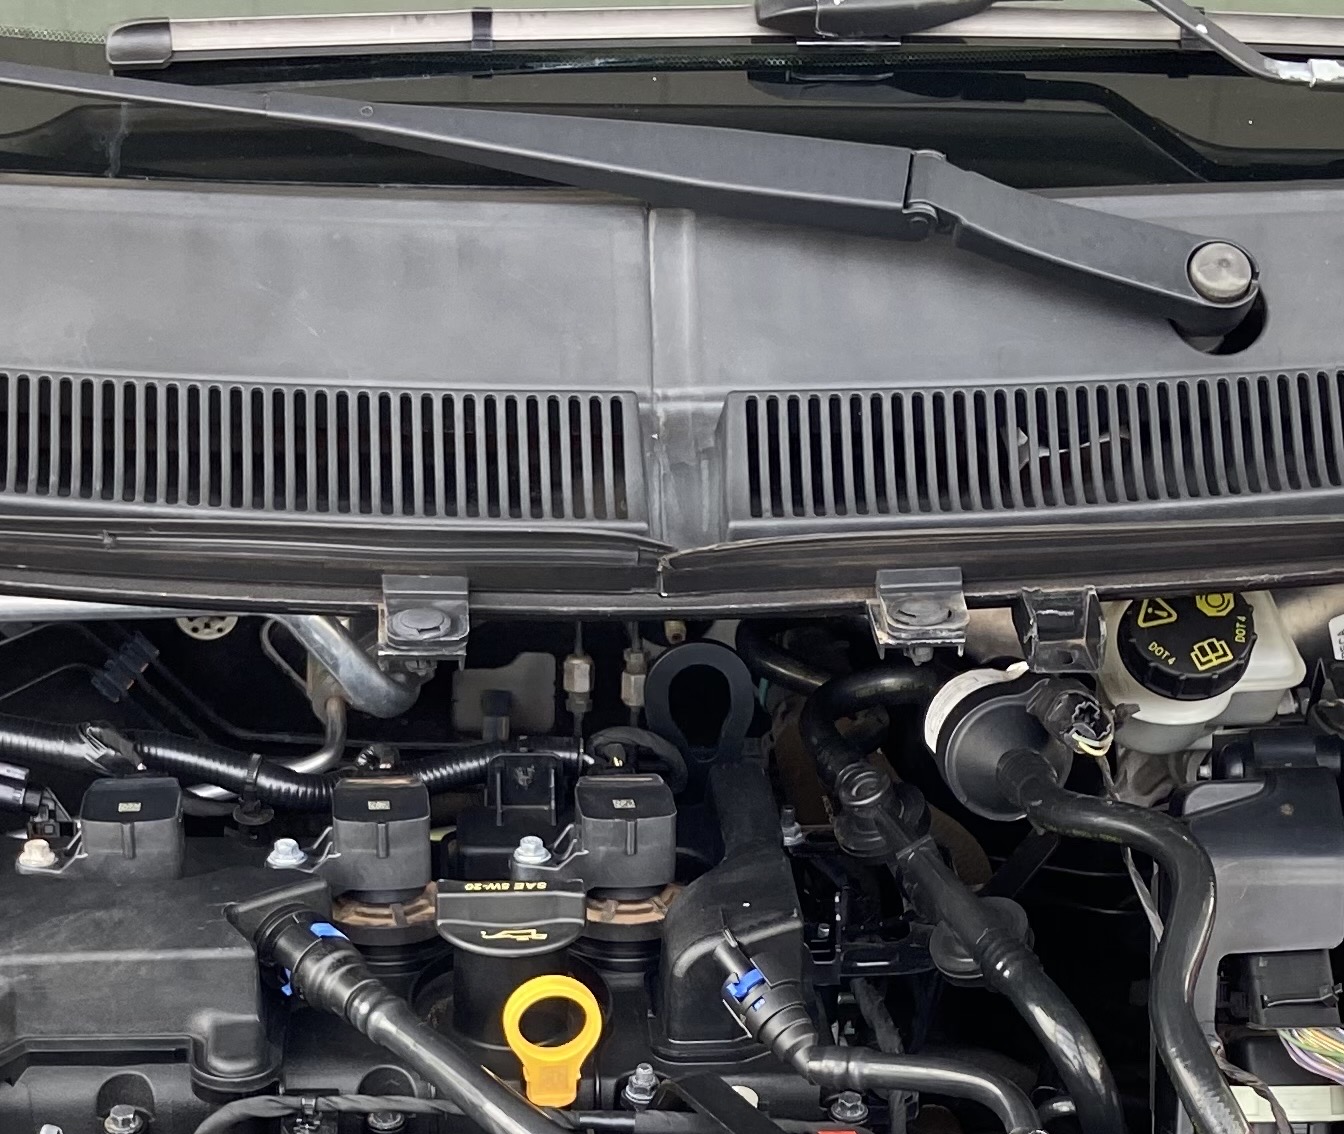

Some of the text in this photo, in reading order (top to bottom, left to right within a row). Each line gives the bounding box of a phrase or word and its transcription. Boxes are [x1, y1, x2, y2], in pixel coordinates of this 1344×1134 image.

[1235, 615, 1247, 643] DOT 4
[1148, 641, 1177, 665] DOT 4
[464, 882, 548, 891] SAE 5W-20
